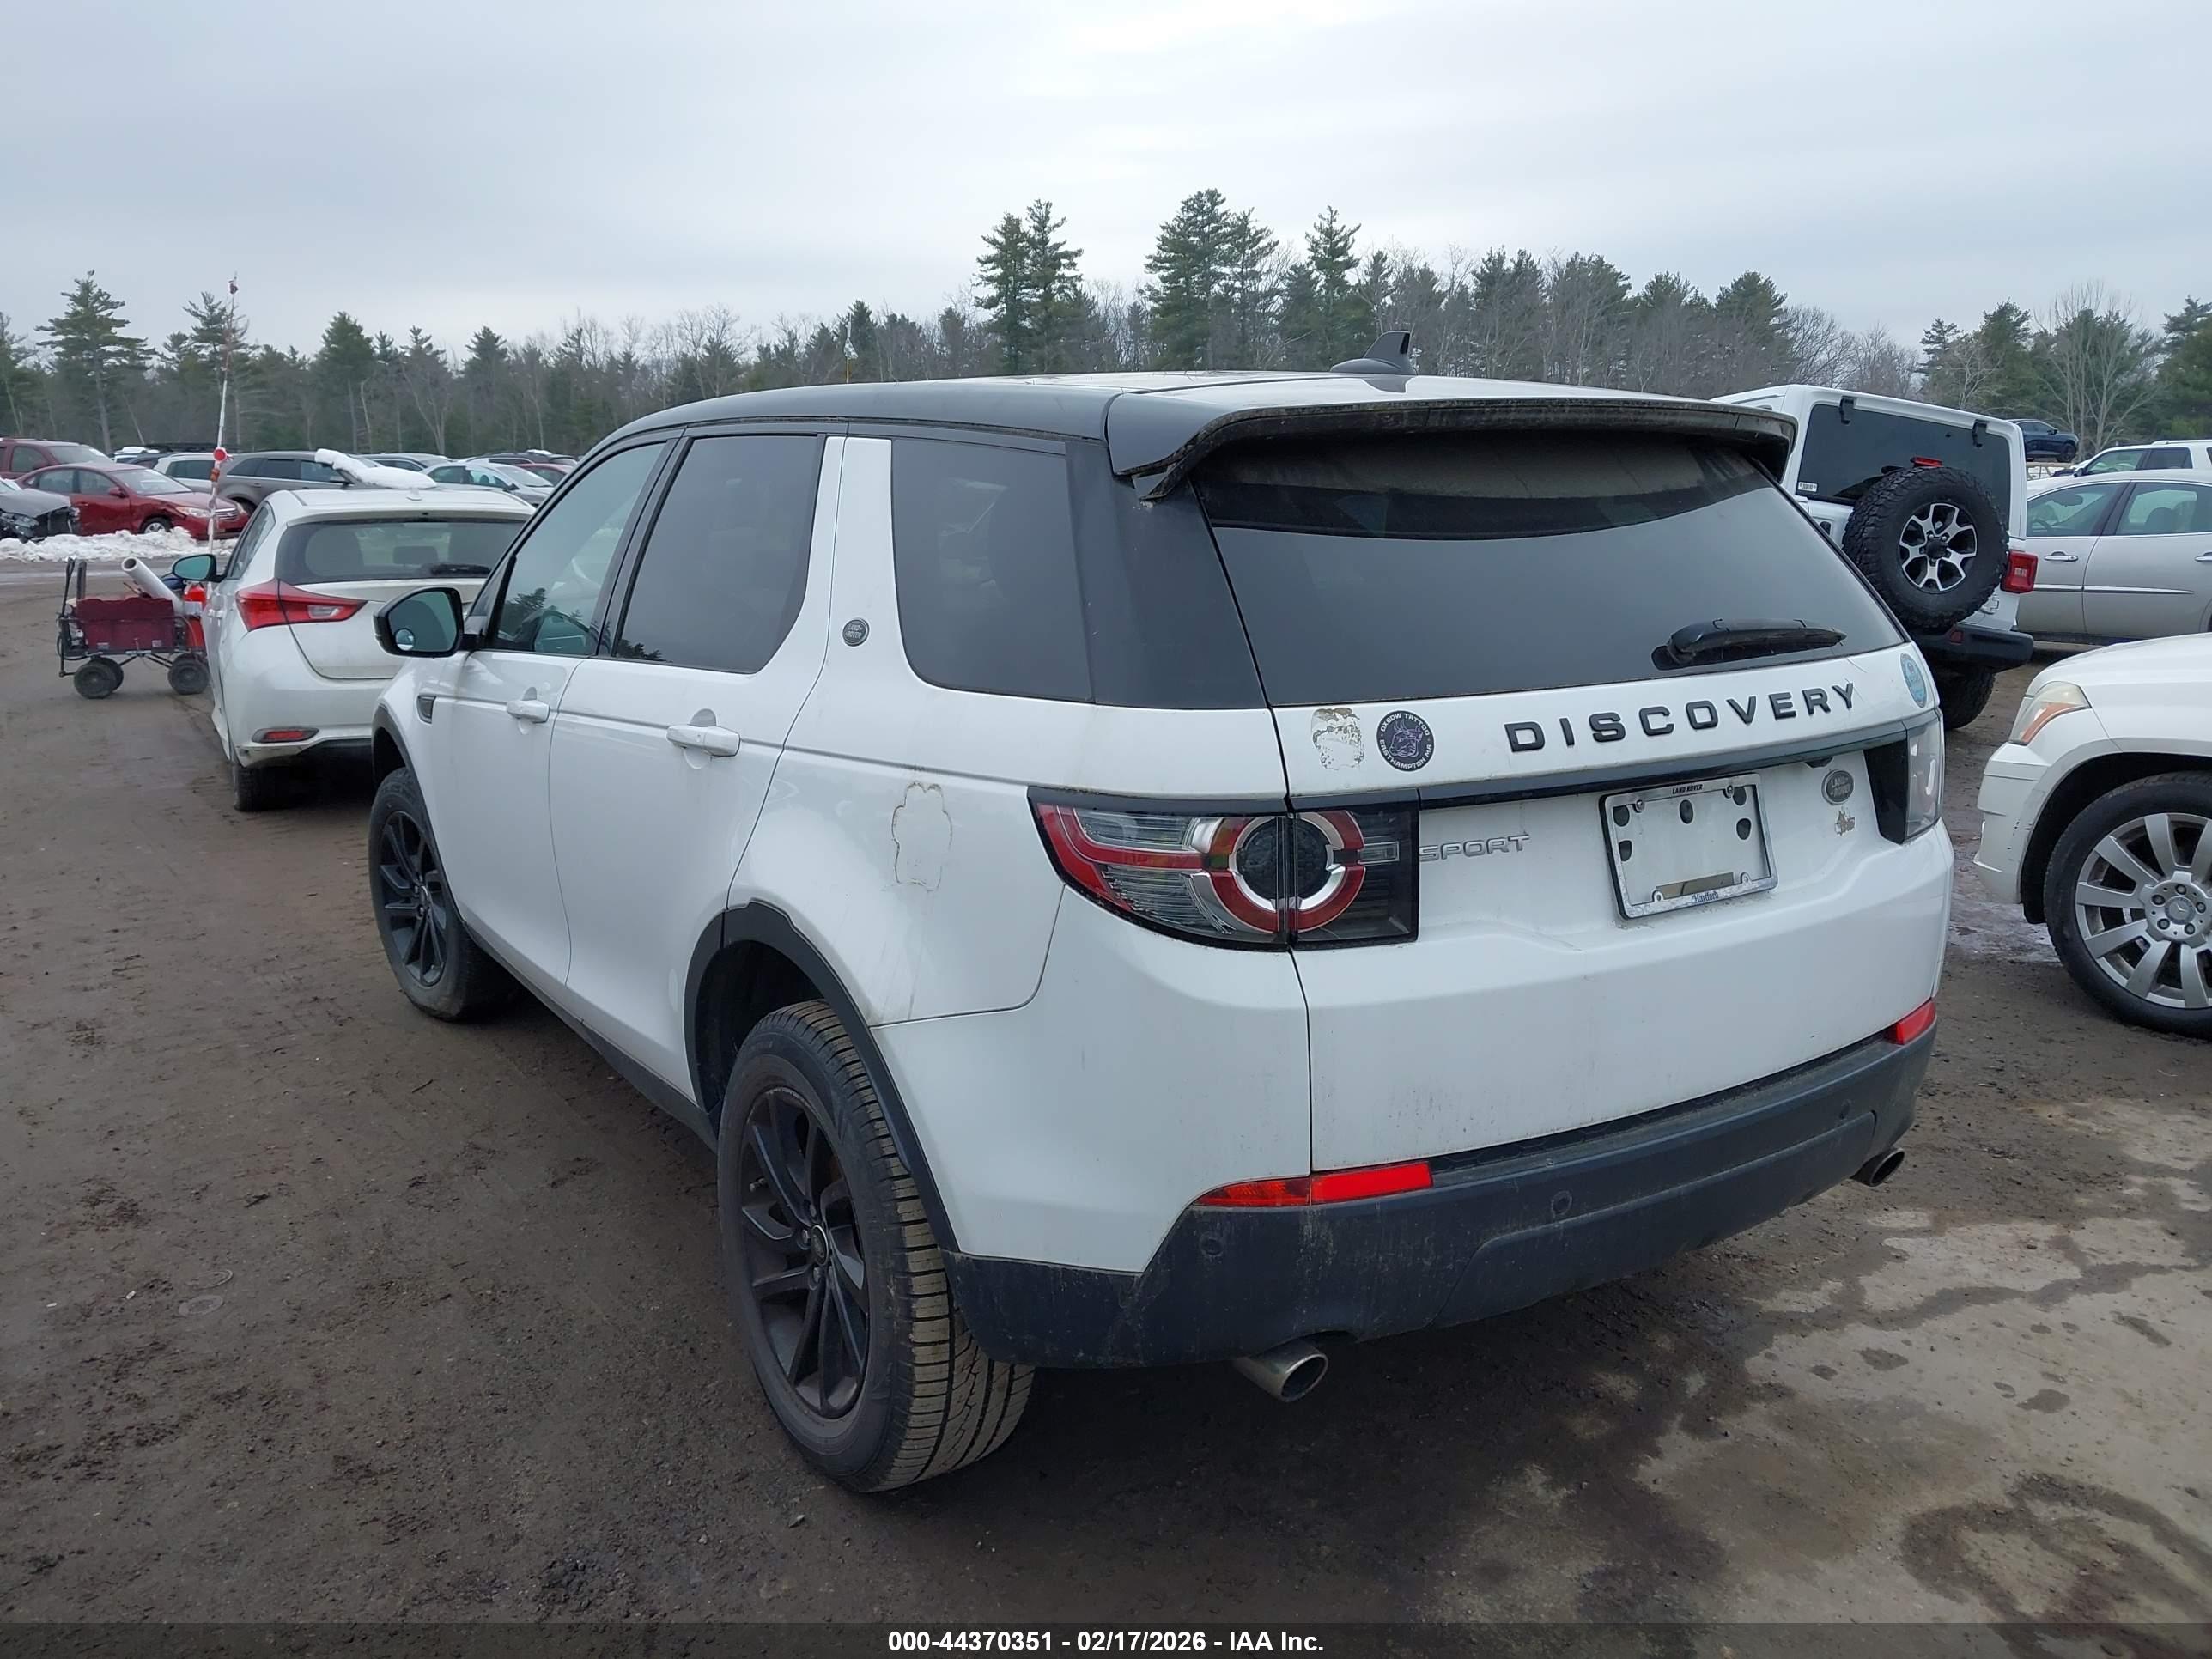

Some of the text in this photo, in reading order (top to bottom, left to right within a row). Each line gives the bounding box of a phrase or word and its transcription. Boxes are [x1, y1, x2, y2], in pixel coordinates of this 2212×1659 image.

[1381, 713, 1430, 735] OXBOW TATTOO
[1504, 683, 1854, 752] DISCOVERY
[1380, 739, 1432, 769] EASTHAMPTON MA
[1672, 786, 1686, 794] LAND
[1419, 834, 1529, 862] SPORT
[1692, 890, 1718, 903] Hartford
